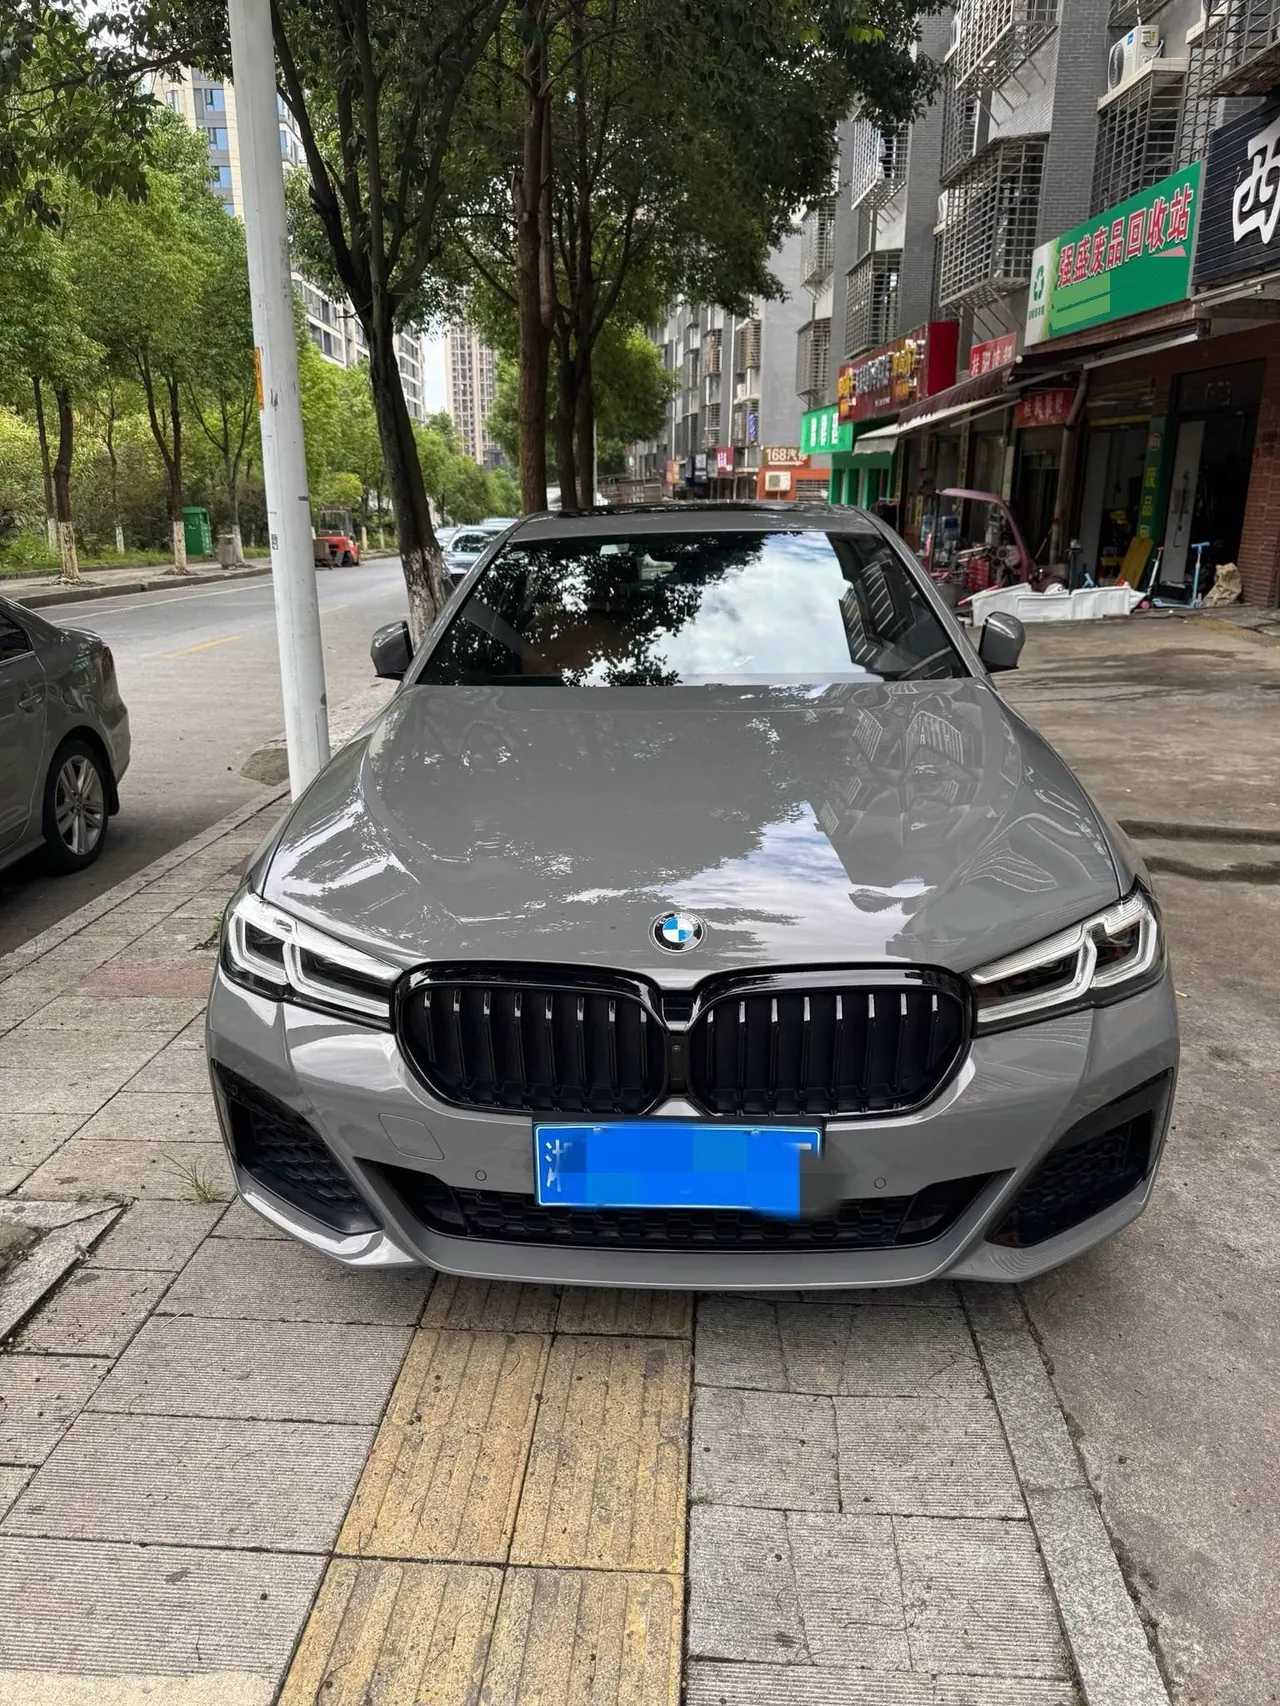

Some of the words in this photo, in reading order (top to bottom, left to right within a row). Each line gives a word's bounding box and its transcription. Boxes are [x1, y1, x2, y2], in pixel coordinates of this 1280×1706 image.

[1057, 183, 1194, 290] 强盛废品回收站
